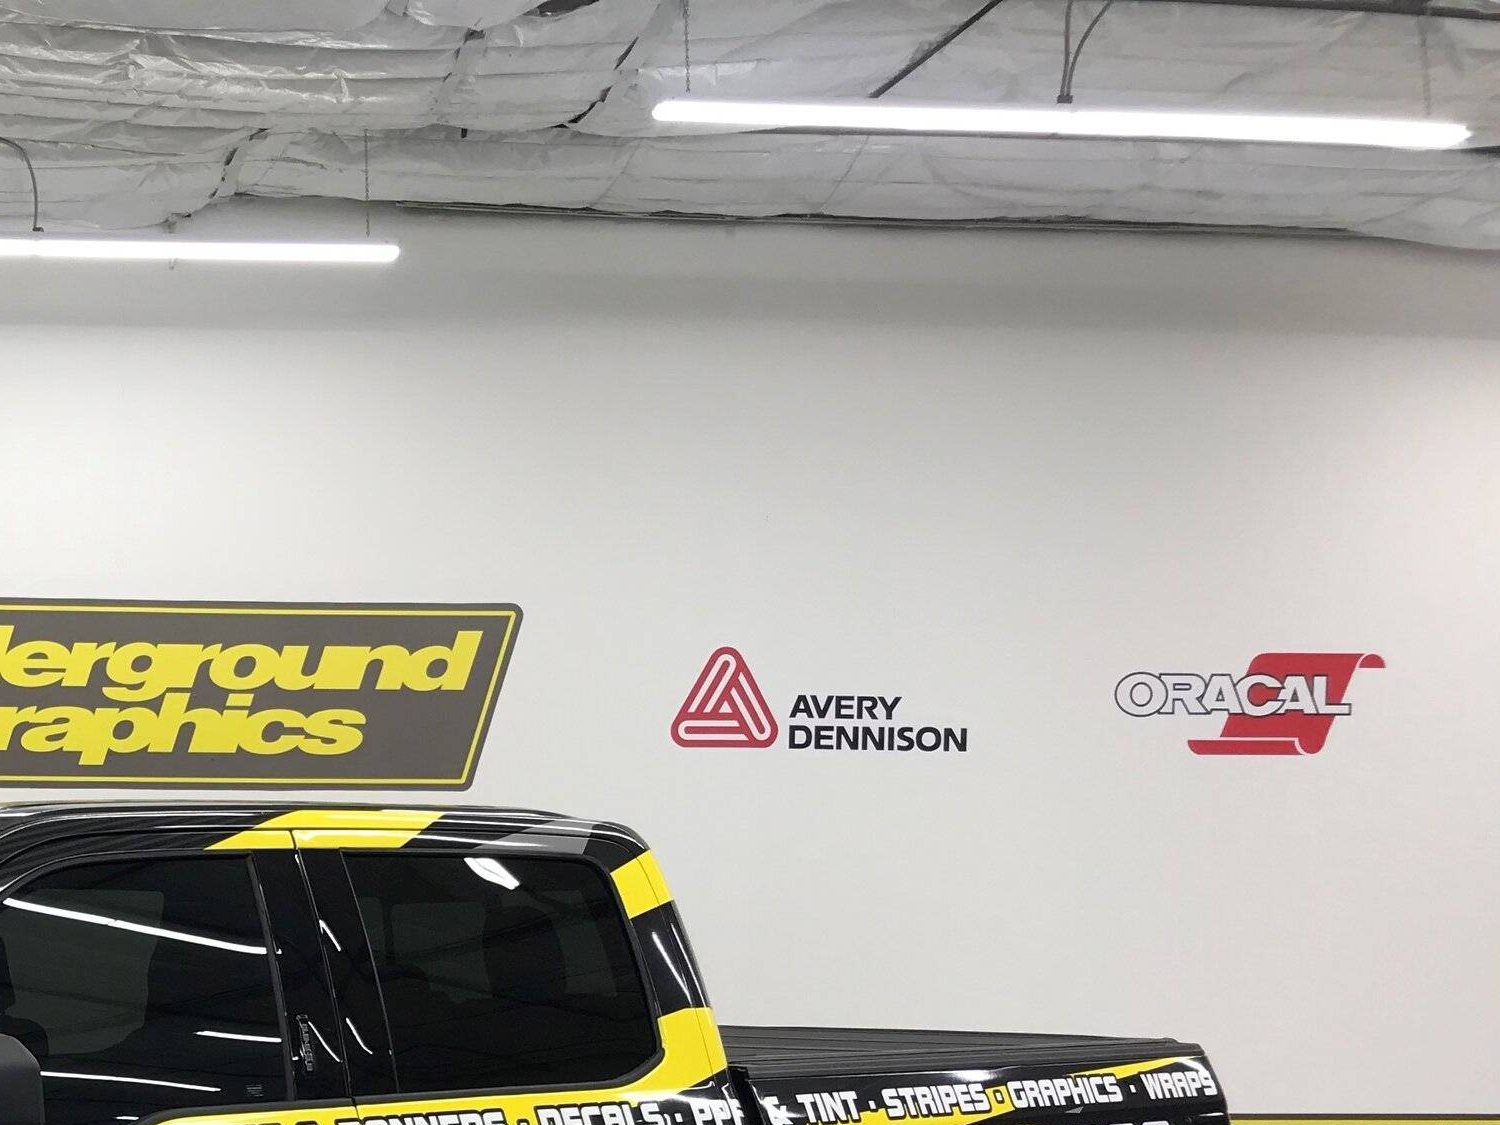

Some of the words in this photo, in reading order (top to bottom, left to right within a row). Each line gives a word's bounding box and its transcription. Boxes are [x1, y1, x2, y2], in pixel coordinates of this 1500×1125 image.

[789, 695, 902, 721] AVERY
[1115, 671, 1352, 717] ORACAL
[788, 725, 968, 753] DENNISON
[796, 1090, 861, 1125] TINT
[881, 1082, 990, 1119] STRIPES
[1010, 1073, 1124, 1110] GRAPHICS
[1140, 1068, 1217, 1100] WRAPS
